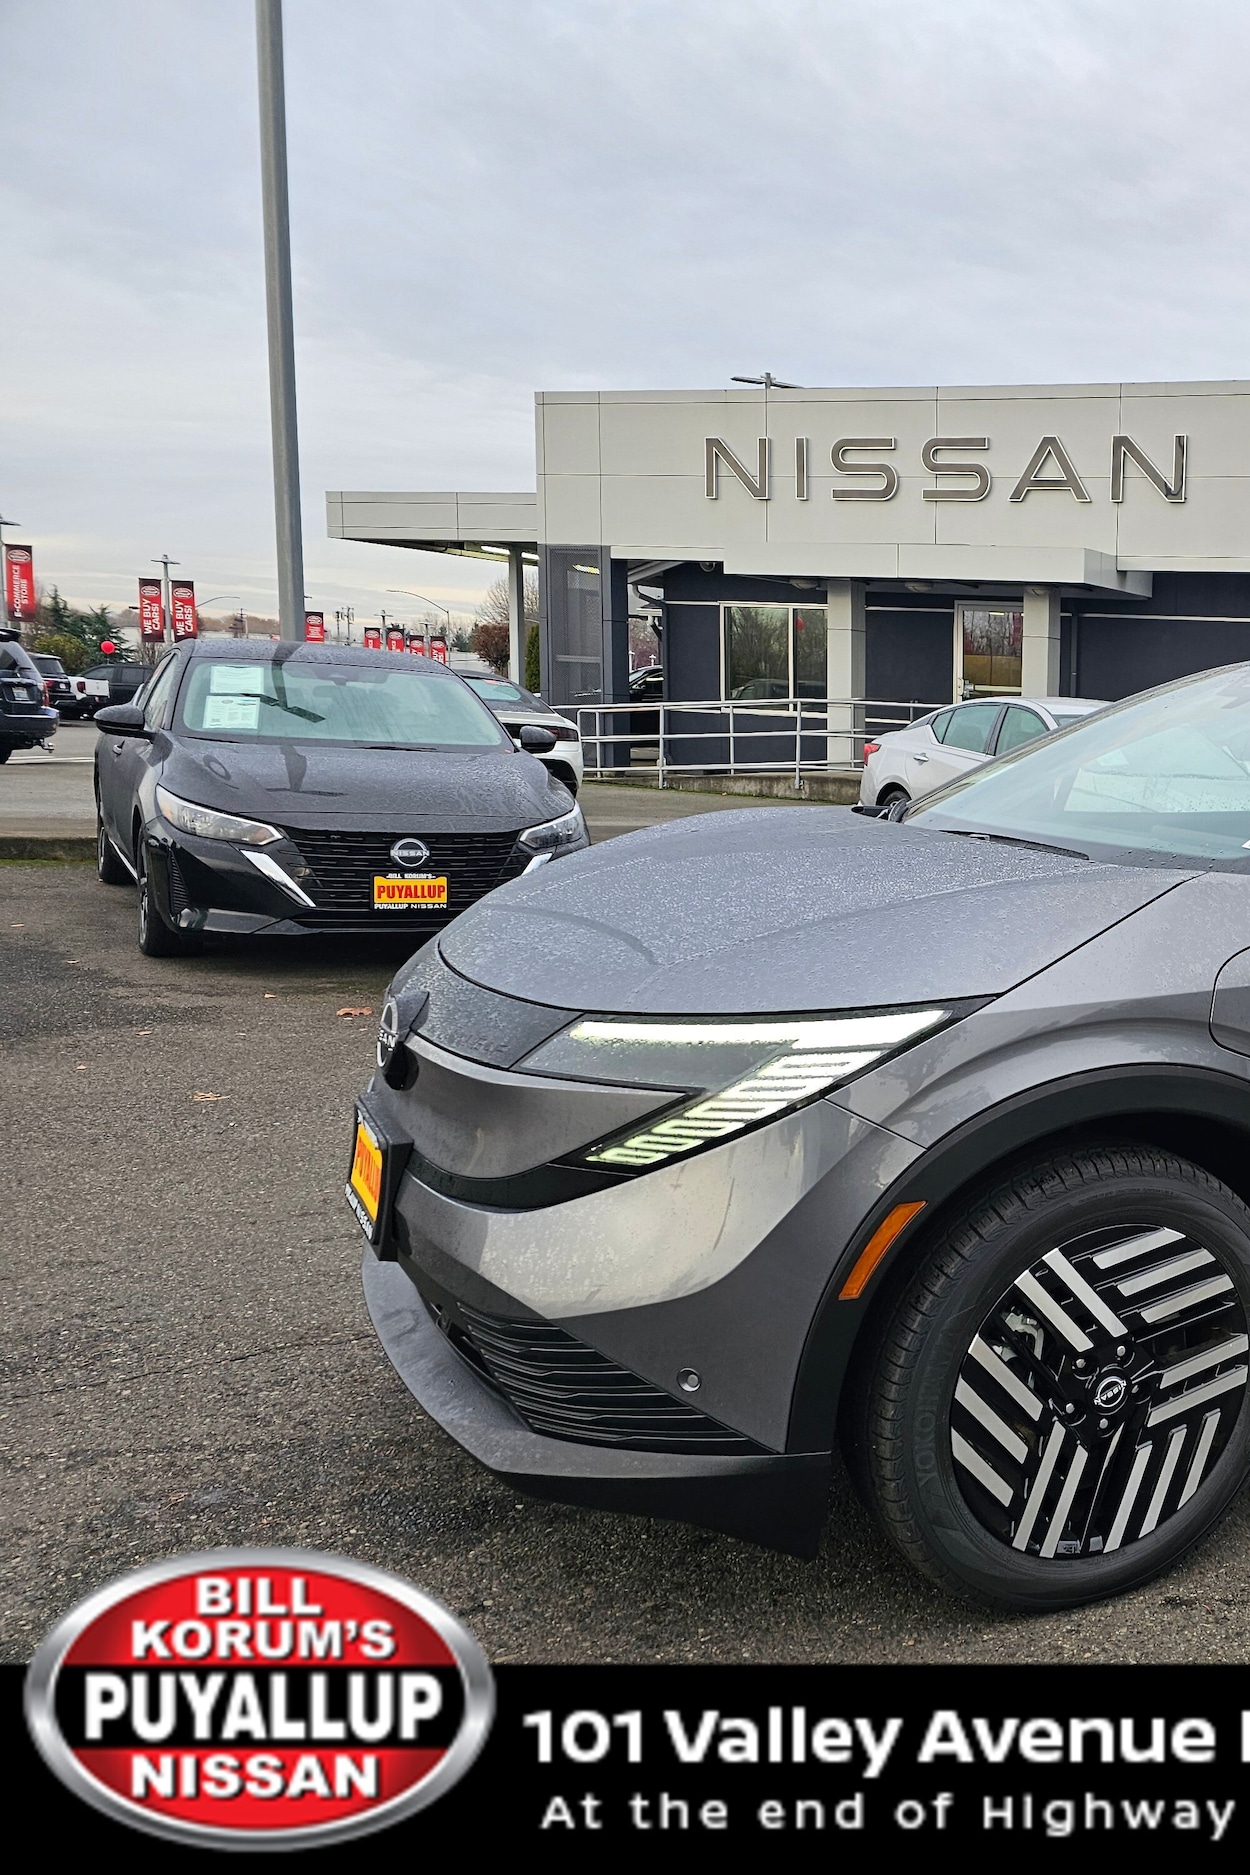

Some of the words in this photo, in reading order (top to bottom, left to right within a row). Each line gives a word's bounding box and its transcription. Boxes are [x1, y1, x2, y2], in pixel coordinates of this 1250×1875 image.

[704, 434, 1188, 503] NISSAN
[12, 565, 22, 618] E-COMMERCE
[21, 579, 29, 605] STORE
[142, 598, 151, 618] BUY
[152, 603, 160, 631] CARS!
[175, 600, 184, 620] BUY
[143, 620, 153, 635] WE
[176, 621, 185, 636] WE
[184, 605, 193, 632] CARS!
[390, 849, 430, 857] NISSAN
[377, 884, 446, 899] PUYALLUP
